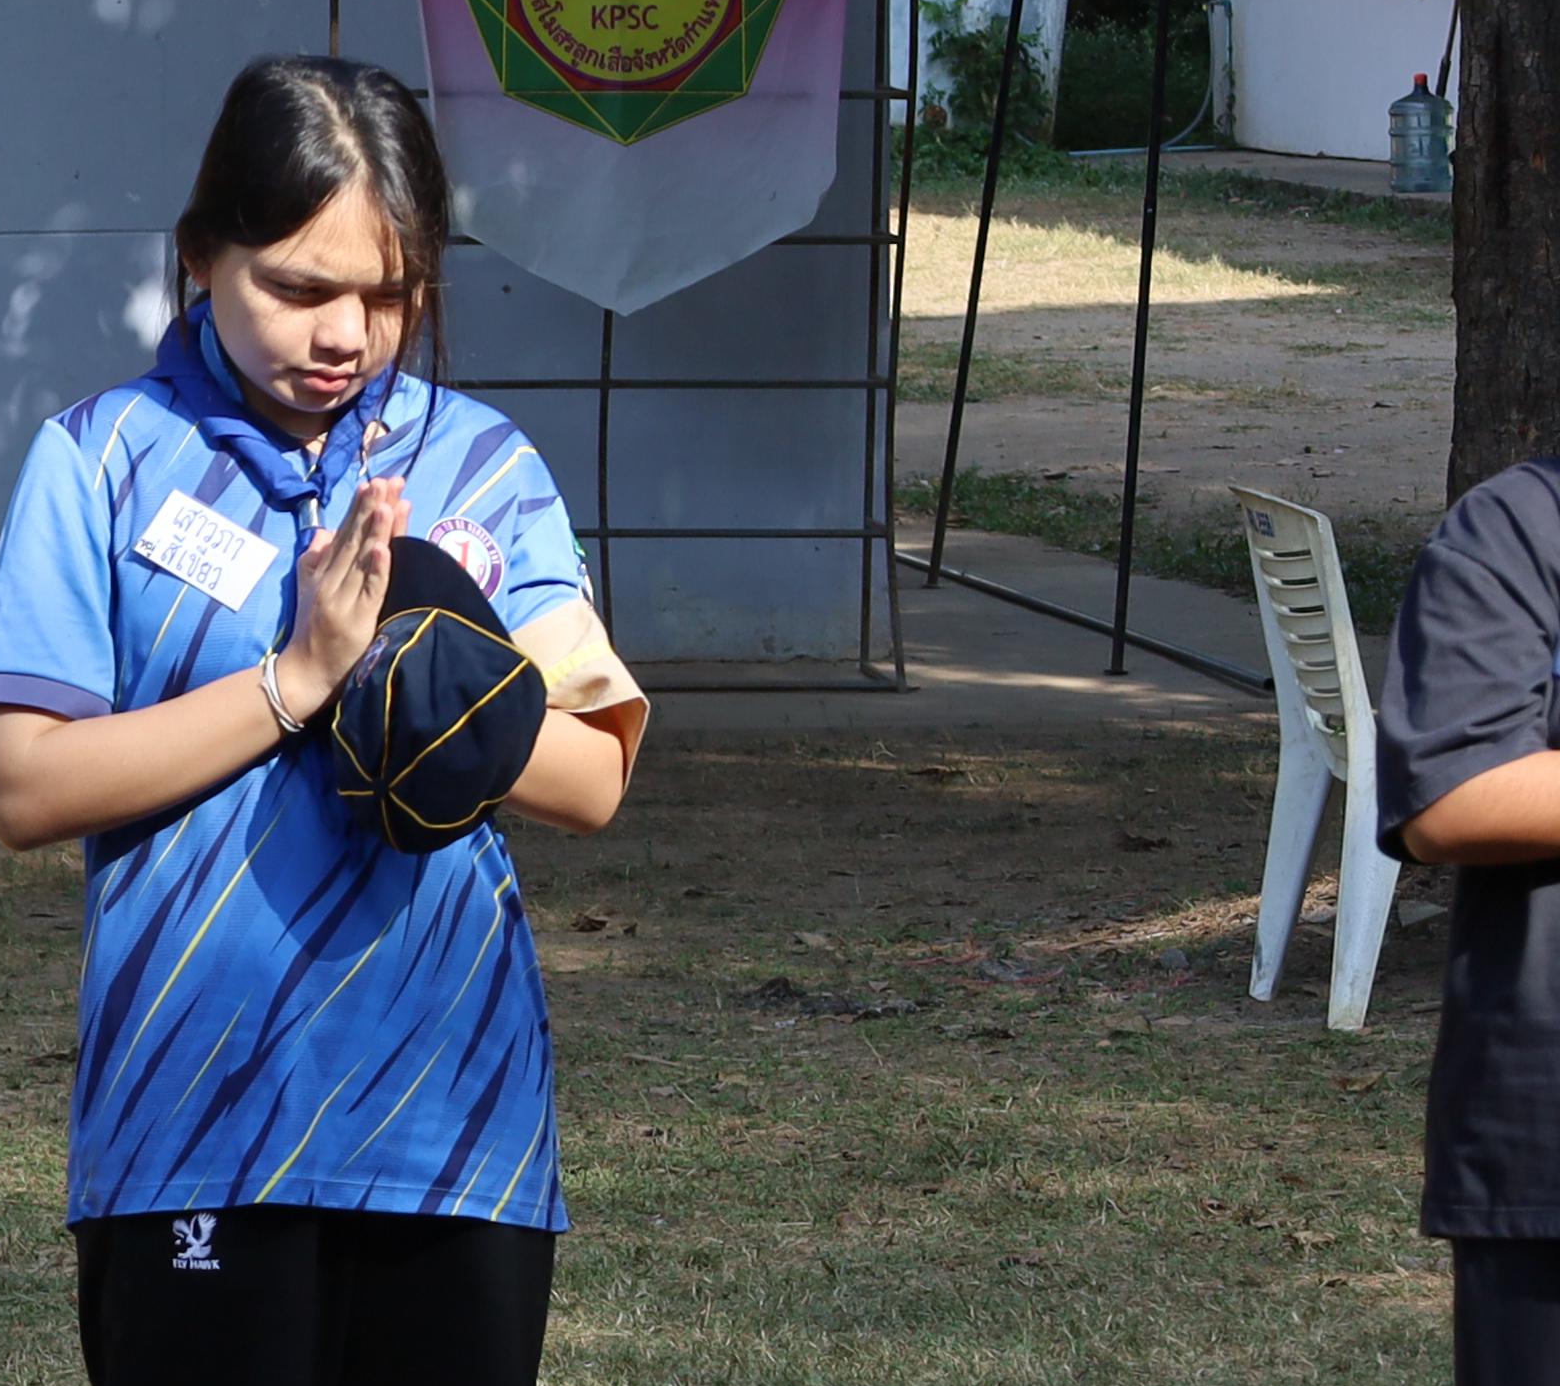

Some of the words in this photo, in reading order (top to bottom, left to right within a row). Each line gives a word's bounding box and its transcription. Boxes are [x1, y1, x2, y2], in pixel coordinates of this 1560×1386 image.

[591, 4, 659, 30] KPSC
[172, 506, 245, 561] เสาวภา
[160, 534, 222, 591] สีเขียว
